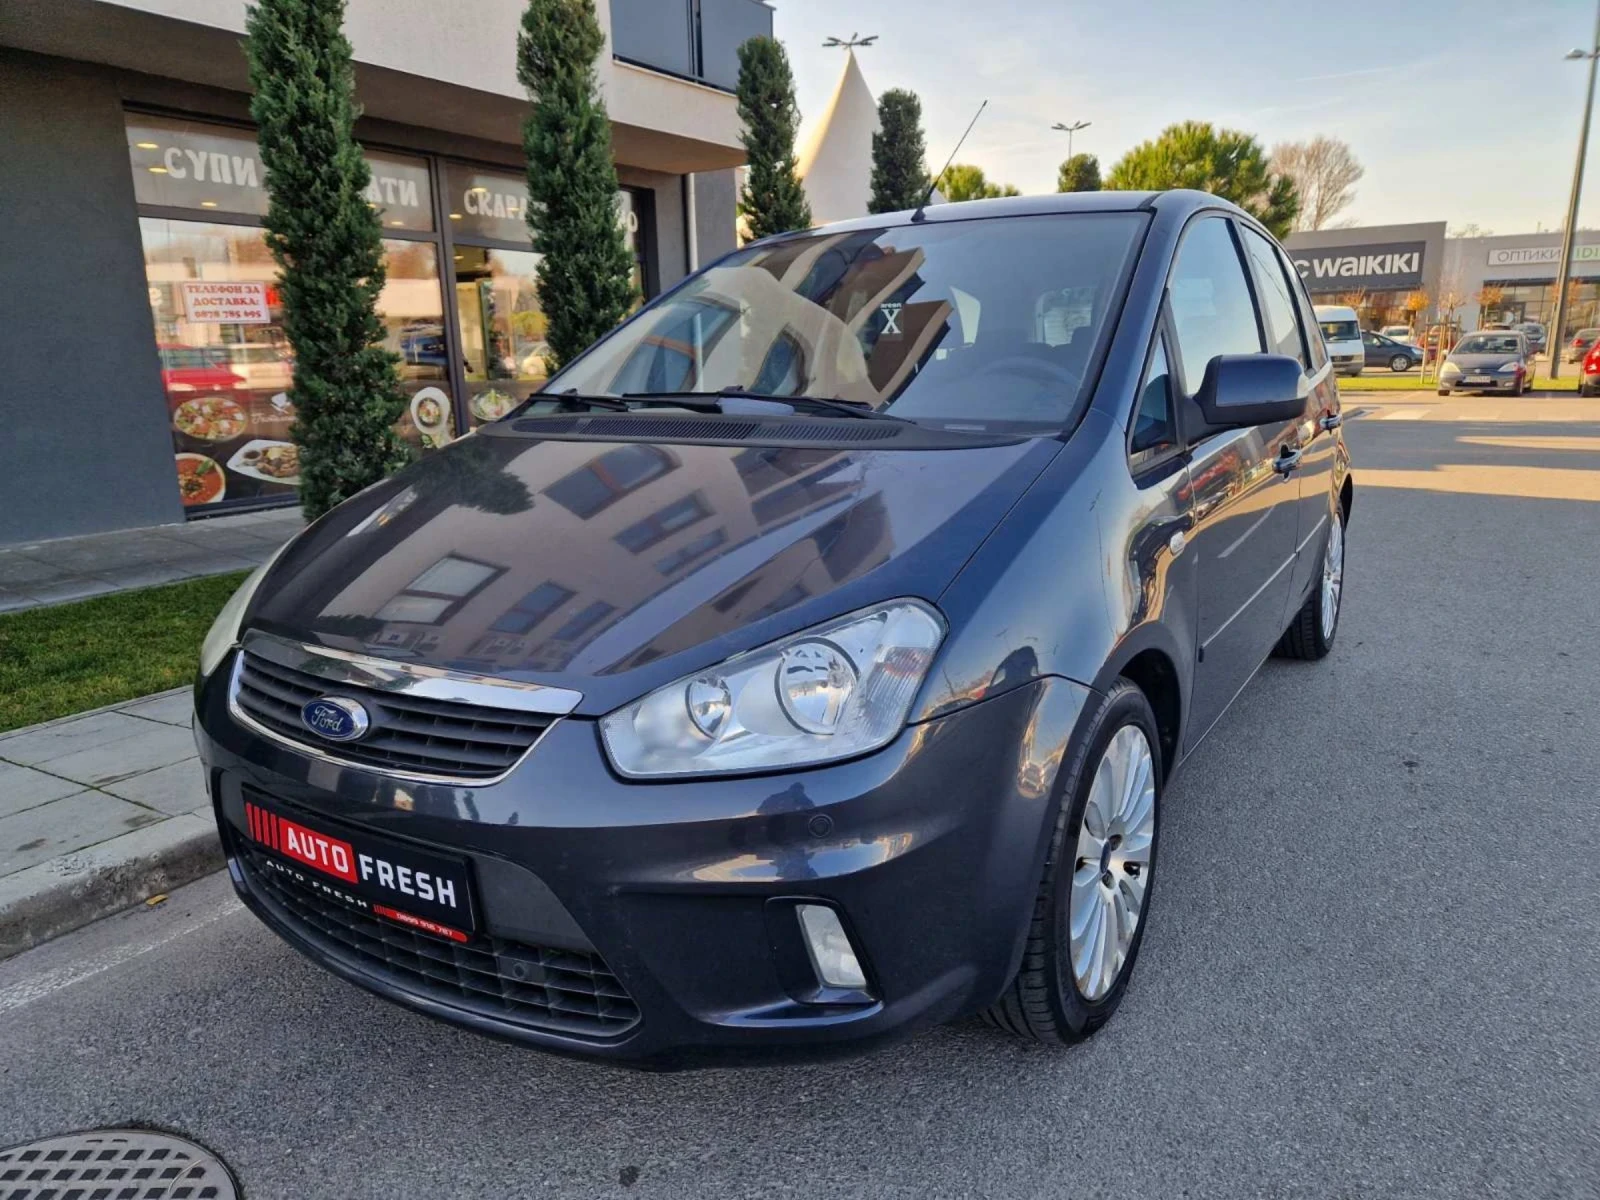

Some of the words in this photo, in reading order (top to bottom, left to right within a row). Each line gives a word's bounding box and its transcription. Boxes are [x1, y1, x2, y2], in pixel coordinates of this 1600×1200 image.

[164, 147, 258, 188] СУПИ
[364, 175, 419, 207] АТИ
[1497, 249, 1561, 262] ОПТИКИ
[187, 285, 242, 294] ТЕЛЕФОН
[244, 285, 260, 294] ЗА
[880, 309, 902, 334] X
[312, 705, 344, 732] Ford
[287, 827, 349, 873] AUTO
[359, 853, 457, 908] FRESH
[266, 860, 305, 882] AUTO
[313, 881, 368, 908] FRESH
